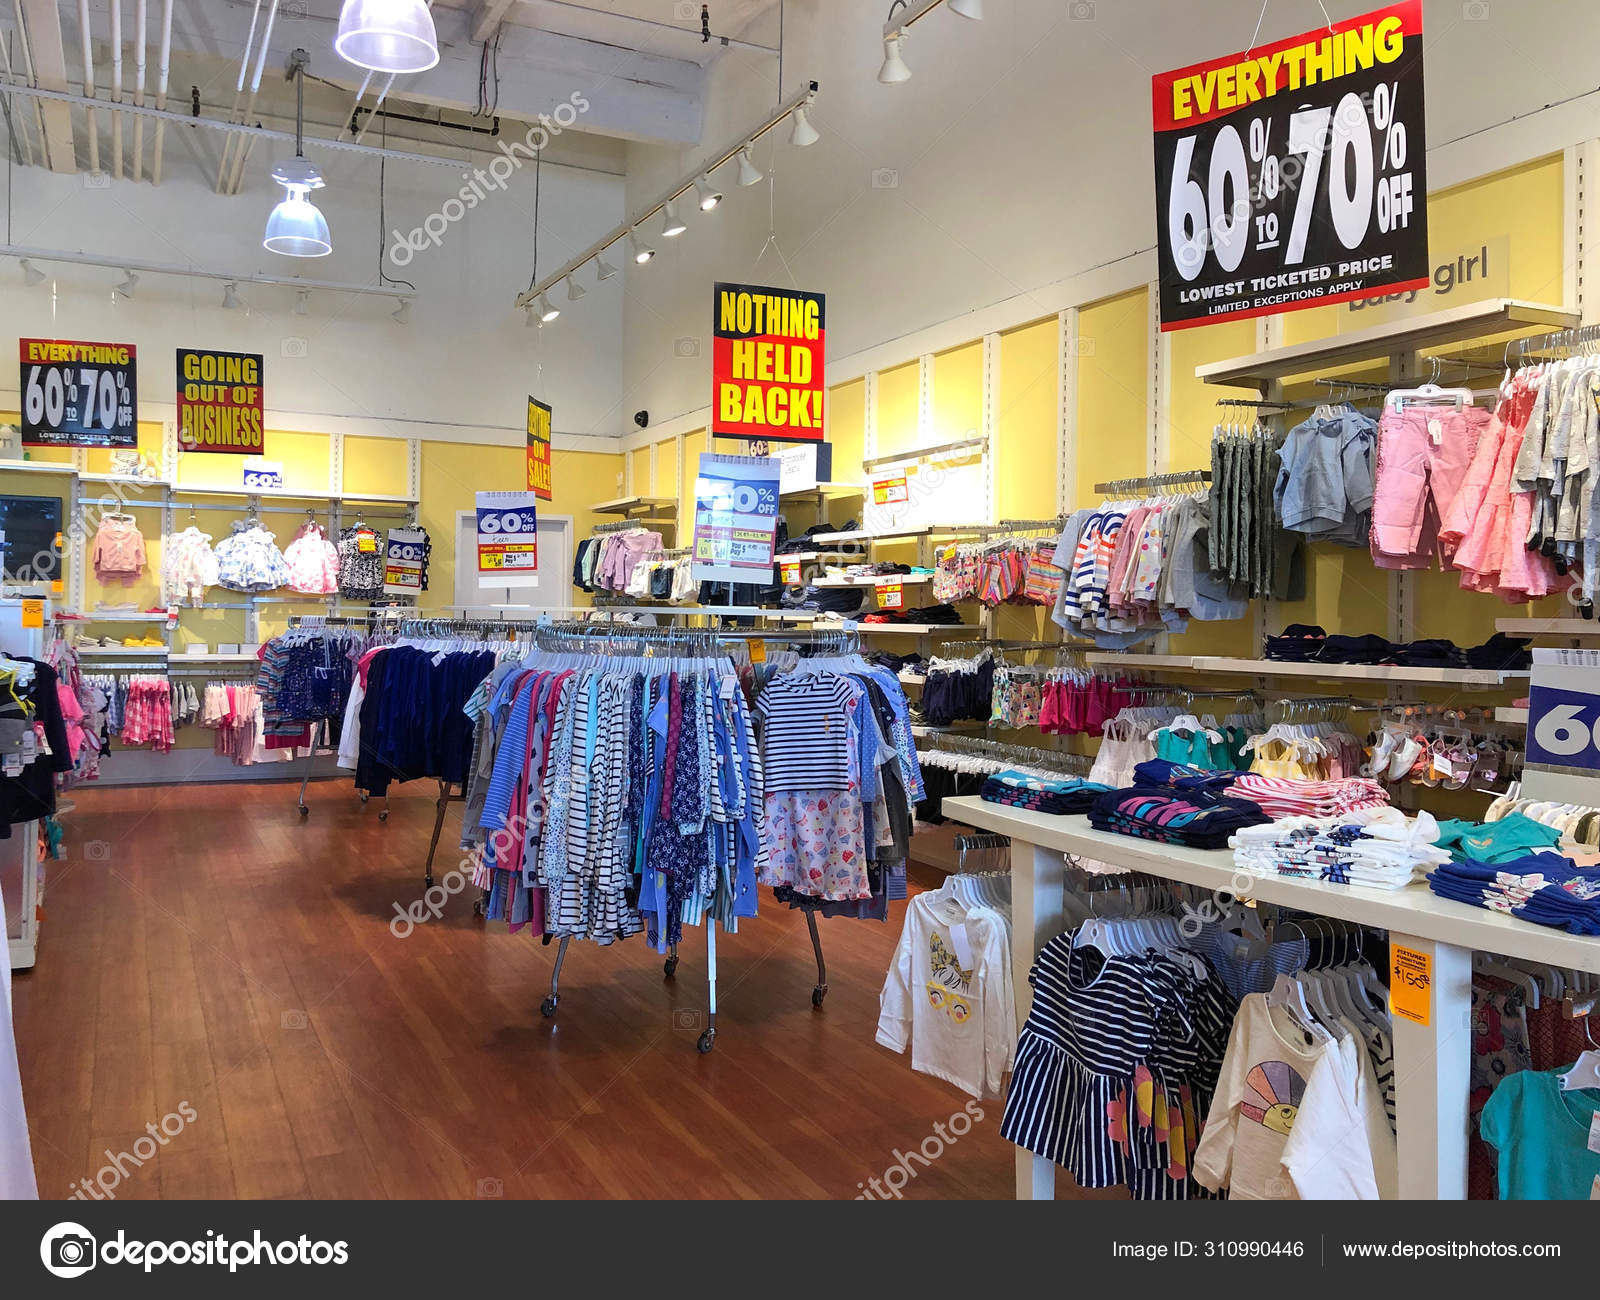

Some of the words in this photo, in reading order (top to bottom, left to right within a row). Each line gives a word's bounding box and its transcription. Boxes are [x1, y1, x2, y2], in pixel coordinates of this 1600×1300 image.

[1173, 16, 1403, 121] EVERYTHING
[1169, 117, 1280, 281] 60%
[1256, 212, 1280, 242] TO
[1285, 81, 1407, 264] 70%
[1377, 172, 1413, 234] OFF
[1180, 281, 1245, 304] LOWEST
[1250, 266, 1332, 292] TICKETED
[1338, 255, 1393, 277] PRICE
[1434, 245, 1488, 295] girl
[720, 291, 819, 340] NOTHING
[1208, 300, 1250, 315] LIMITED
[1254, 286, 1324, 307] EXCEPTIONS
[1328, 280, 1364, 295] APPLY
[28, 343, 129, 365] EVERYTHING
[183, 354, 258, 384] GOING
[732, 340, 812, 384] HELD
[26, 366, 78, 427] 60%
[66, 407, 77, 420] TO
[80, 369, 130, 430] 70%
[118, 406, 132, 427] OFF
[184, 383, 228, 402] OUT
[232, 386, 258, 404] OF
[720, 383, 823, 428] BACK!
[39, 432, 69, 440] LOWEST
[182, 404, 262, 447] BUSINESS
[533, 439, 545, 460] ON
[480, 512, 534, 534] 60%
[522, 524, 535, 532] OFF
[757, 503, 775, 514] OFF
